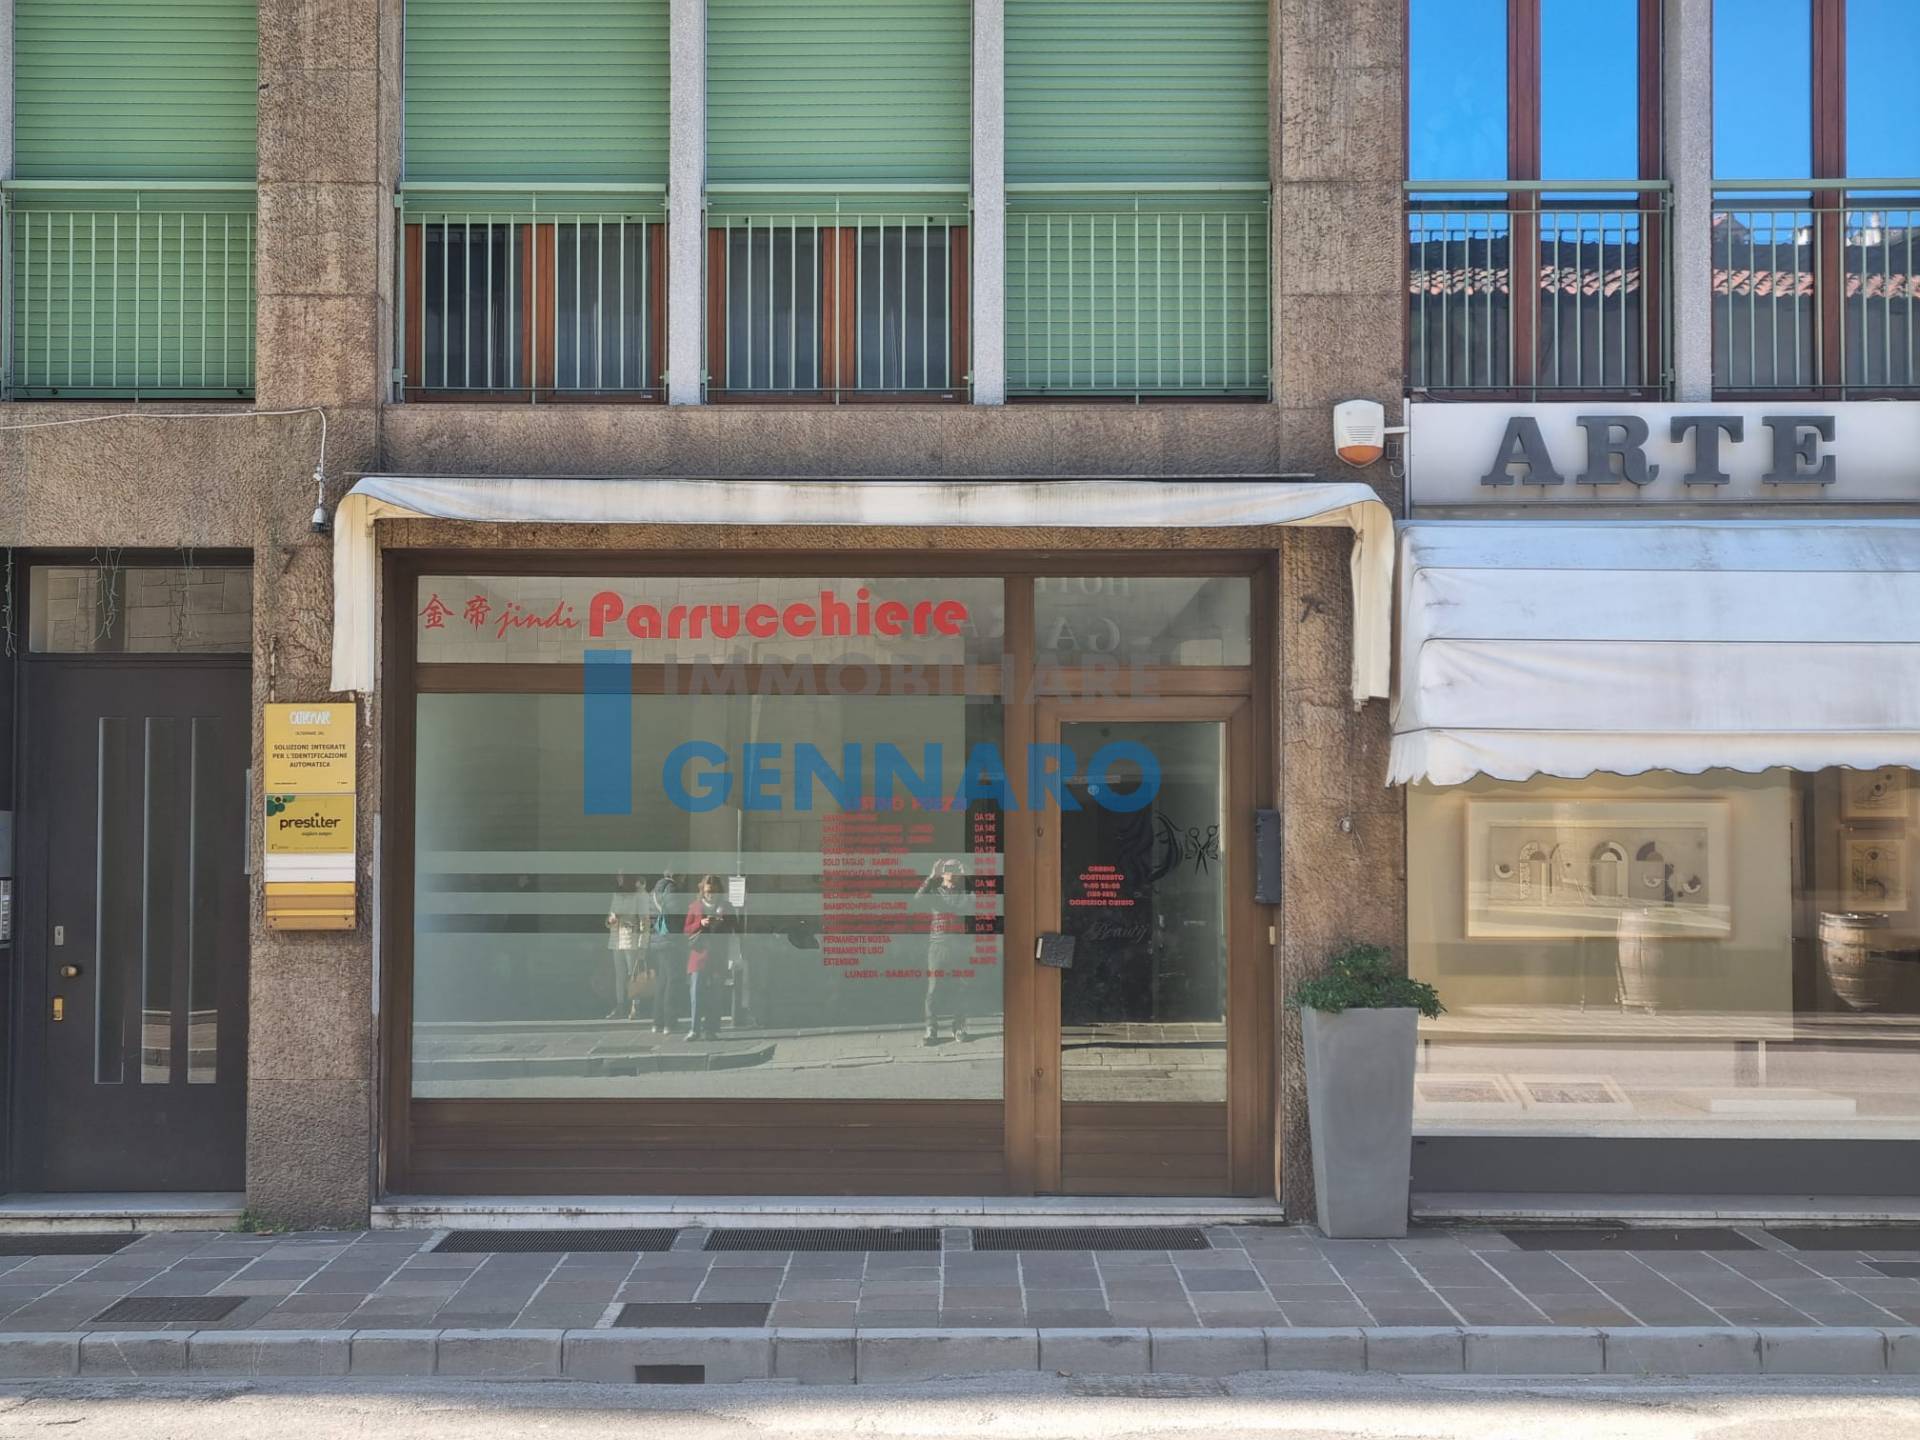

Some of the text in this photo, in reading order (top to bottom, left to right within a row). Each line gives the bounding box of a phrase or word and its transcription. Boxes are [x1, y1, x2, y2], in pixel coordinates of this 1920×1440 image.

[1480, 415, 1836, 487] ARTE
[588, 587, 969, 640] Parrucchiere
[279, 812, 341, 831] prestiter
